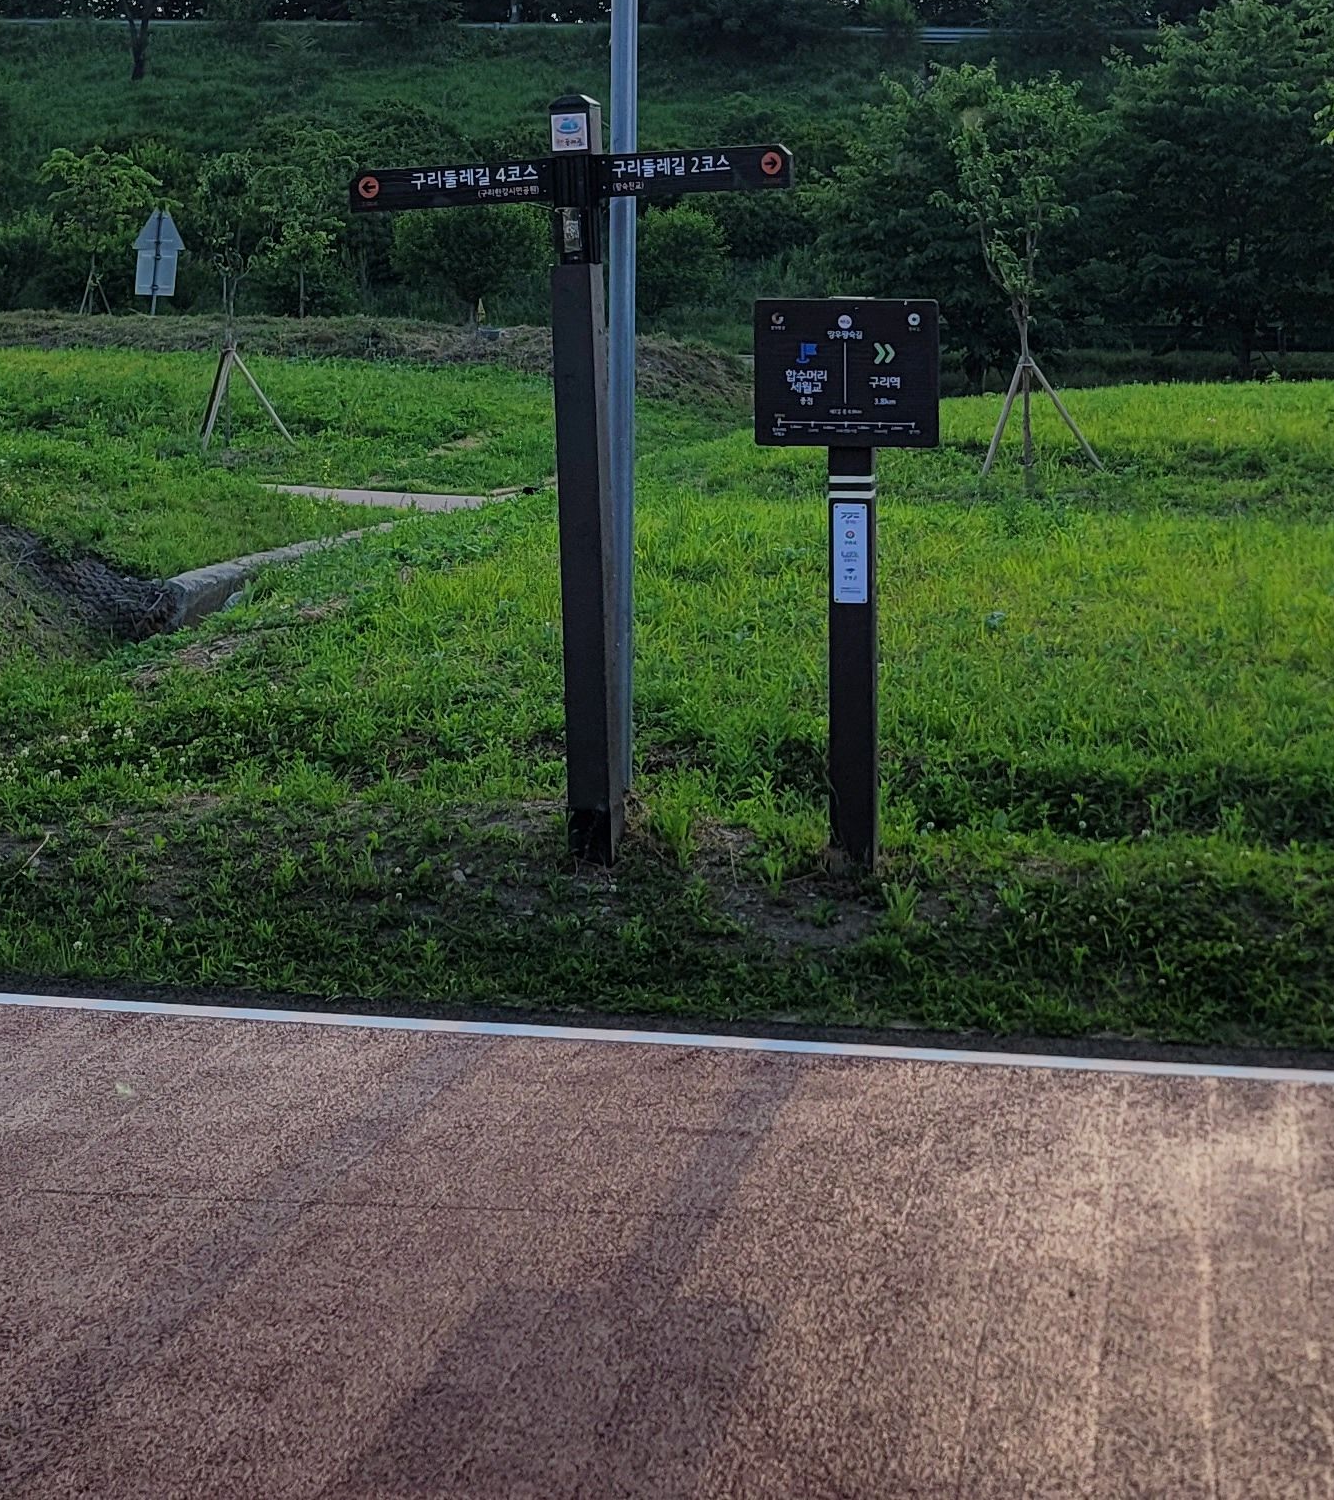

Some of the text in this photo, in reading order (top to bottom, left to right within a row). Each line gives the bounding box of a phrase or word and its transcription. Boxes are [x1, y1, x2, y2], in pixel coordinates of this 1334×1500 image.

[611, 154, 732, 179] 구리둘레길 2코스
[410, 164, 539, 191] 구리둘레길 4코스
[785, 369, 828, 382] 합수머리
[869, 376, 901, 389] 구리역
